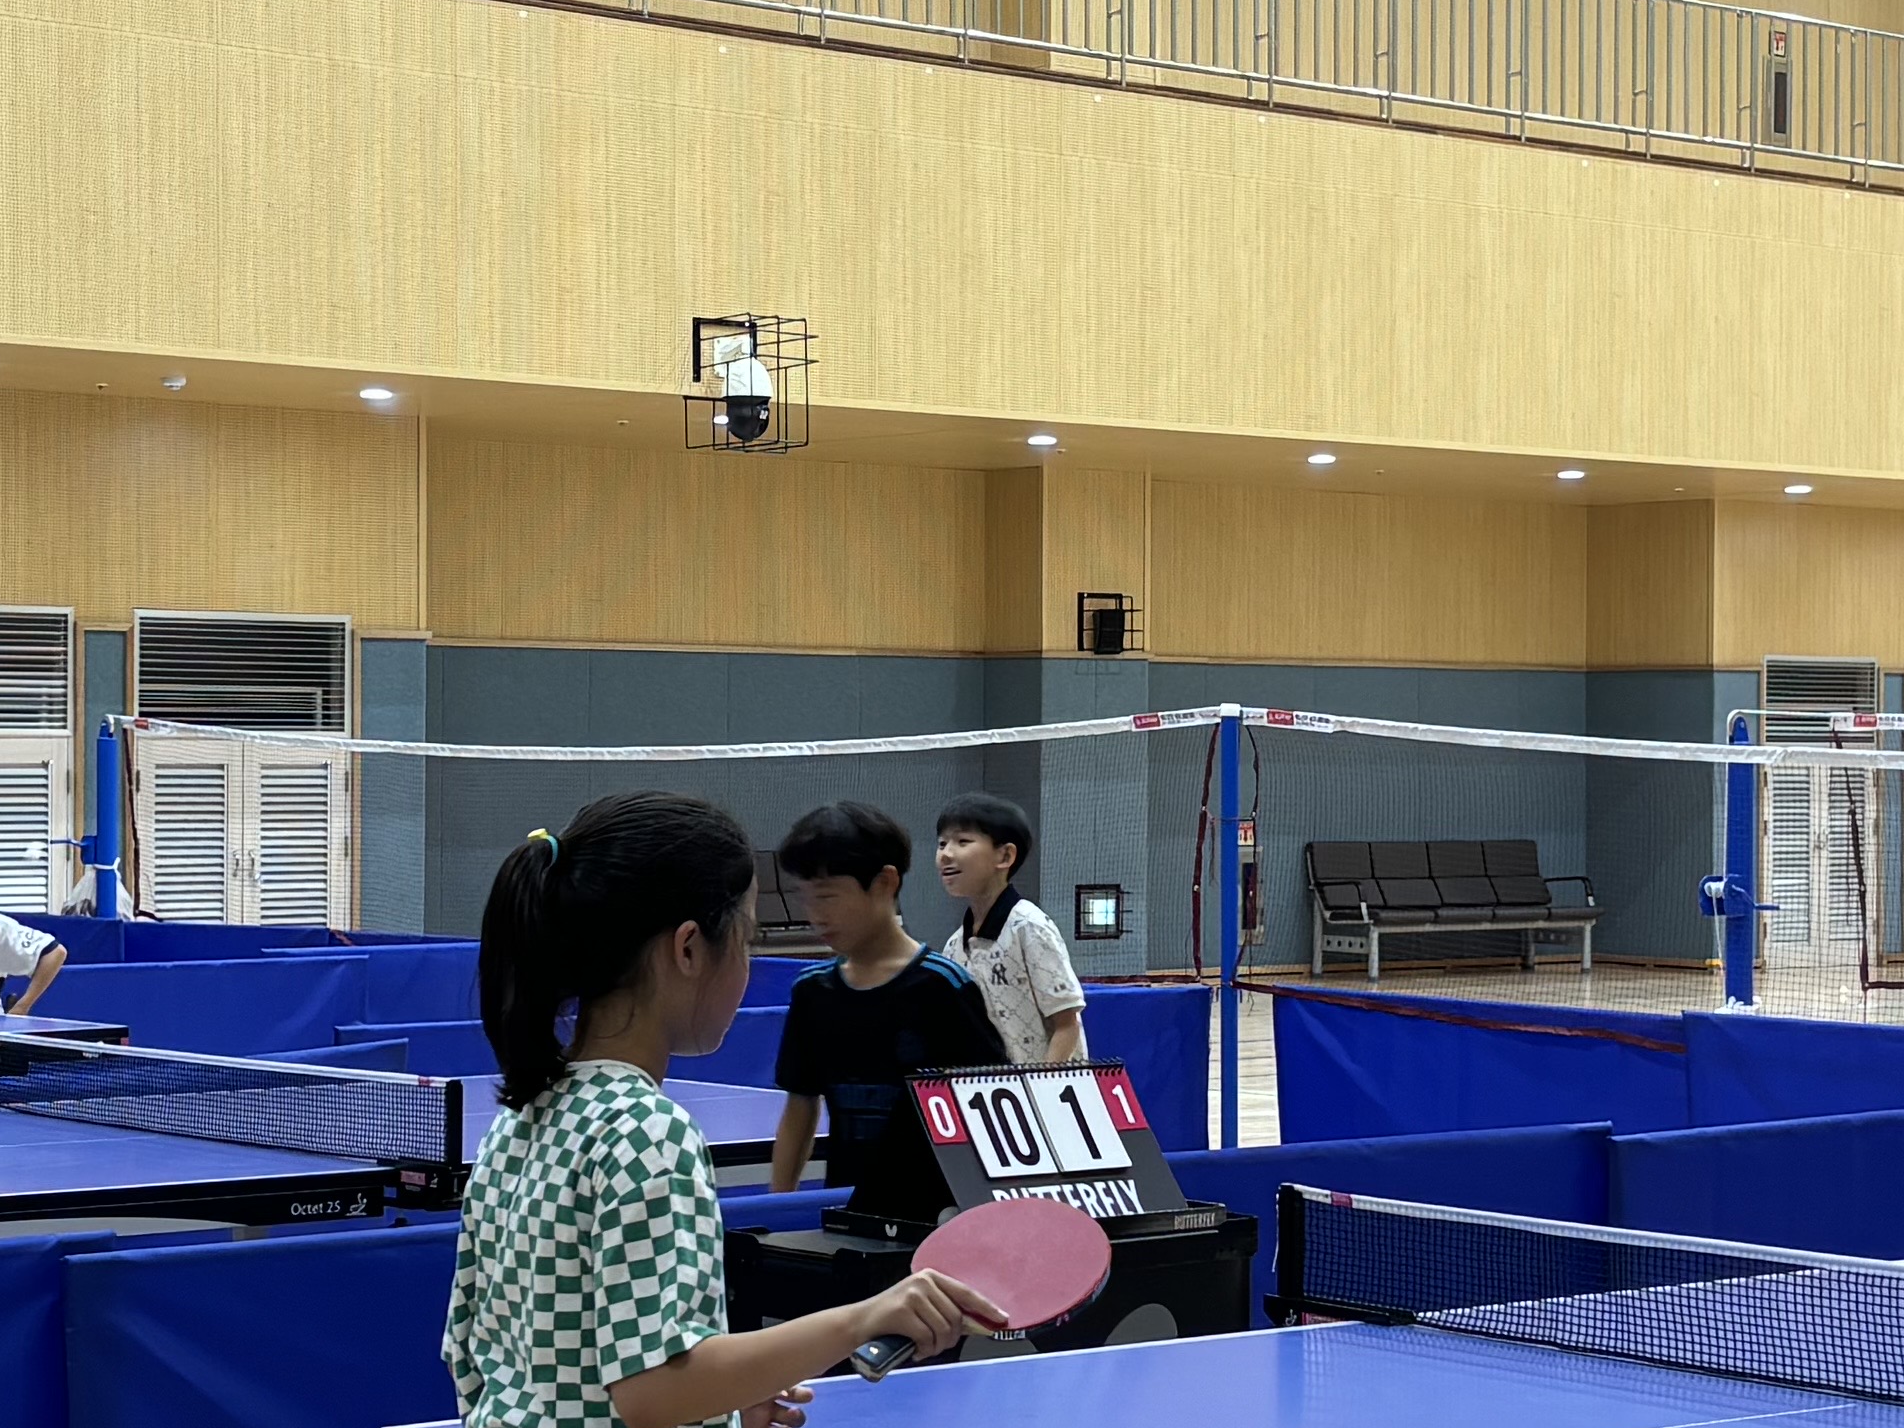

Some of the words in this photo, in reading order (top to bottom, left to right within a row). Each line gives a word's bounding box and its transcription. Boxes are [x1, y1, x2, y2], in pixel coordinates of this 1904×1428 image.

[927, 1096, 957, 1139] 0
[967, 1087, 1041, 1168] 10
[1058, 1084, 1103, 1160] 1
[1111, 1084, 1137, 1124] 1
[327, 1190, 341, 1213] 25
